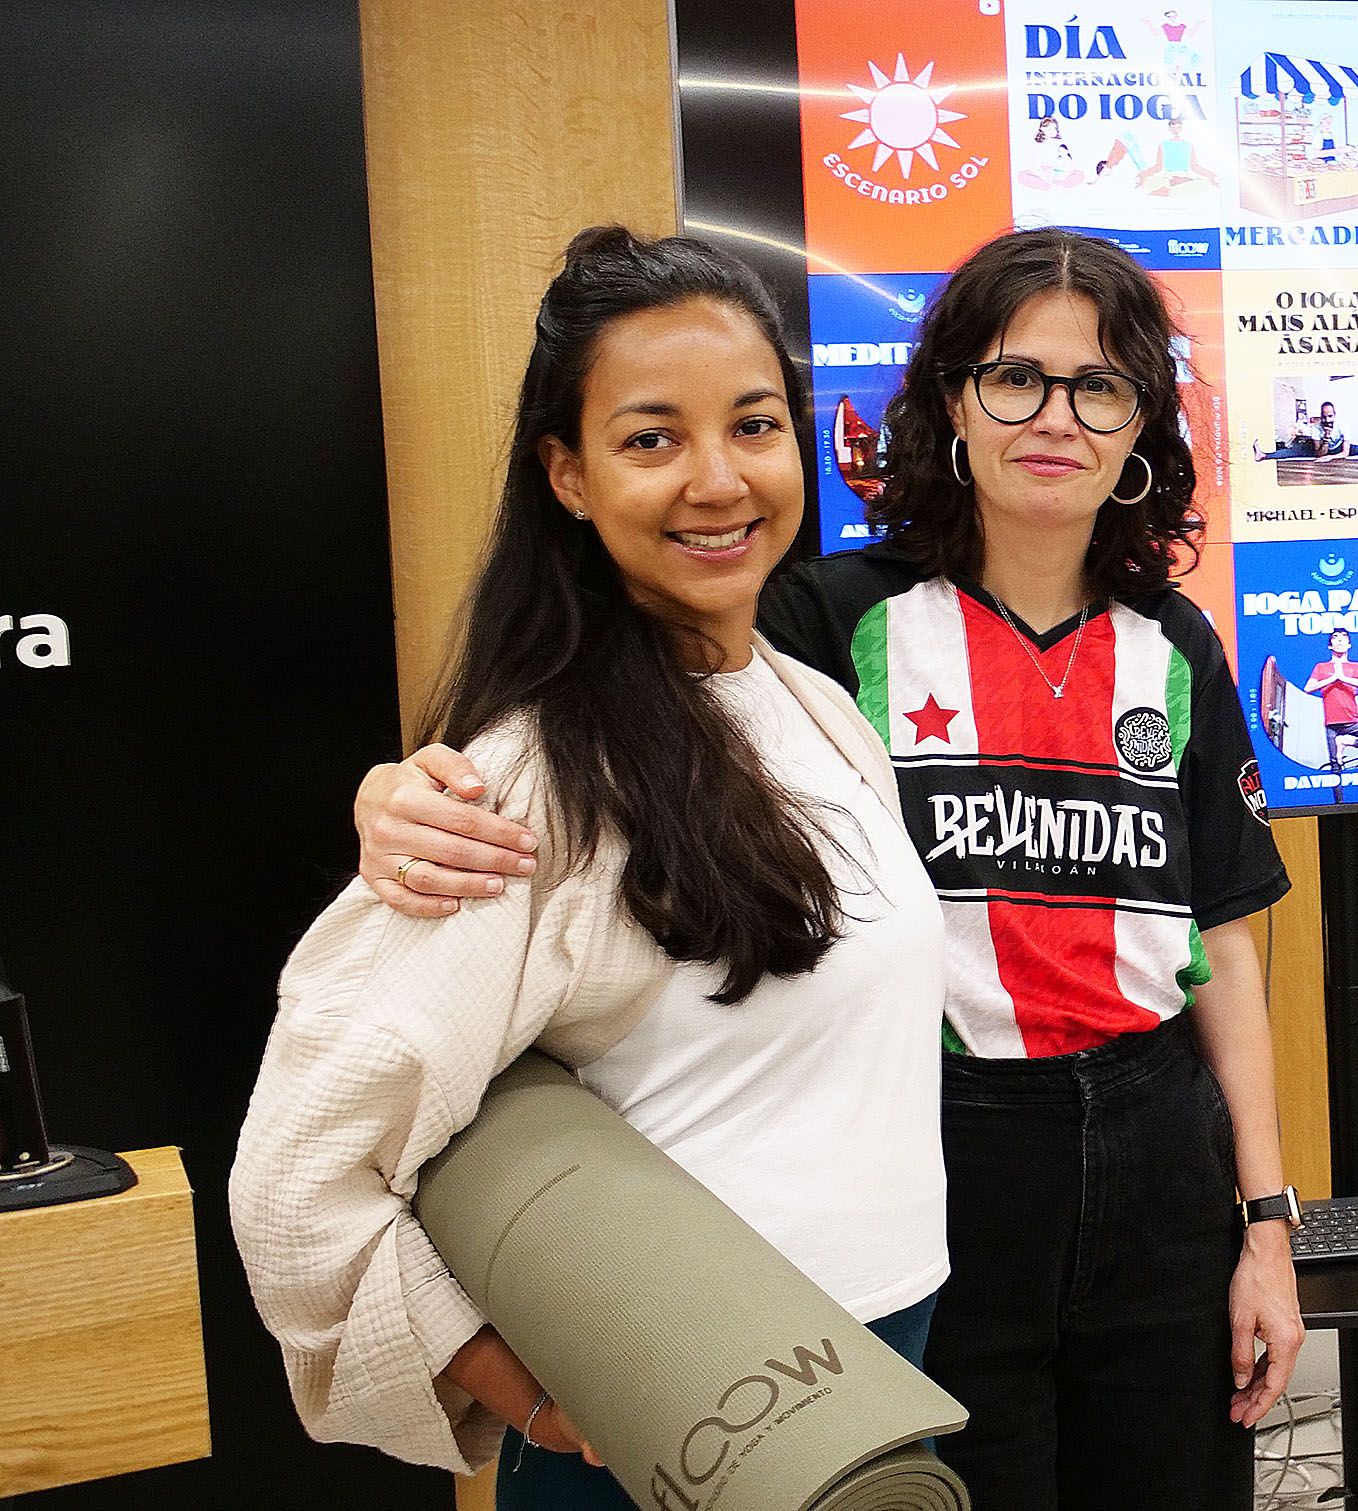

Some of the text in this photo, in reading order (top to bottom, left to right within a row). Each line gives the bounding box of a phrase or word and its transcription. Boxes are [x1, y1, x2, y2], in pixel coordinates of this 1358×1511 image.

[1024, 15, 1127, 59] DÍA
[1026, 71, 1207, 87] INTERNACIONAL
[1028, 94, 1207, 120] DO IOGA
[823, 153, 990, 205] ESCENARIO SOL
[1276, 292, 1294, 309] O
[1246, 507, 1318, 523] MICHAEL
[1243, 592, 1326, 617] IOGA
[1284, 772, 1341, 791] DAVID
[926, 785, 1167, 868] REVENIDAS
[773, 1386, 833, 1425] MOVIMIENTO
